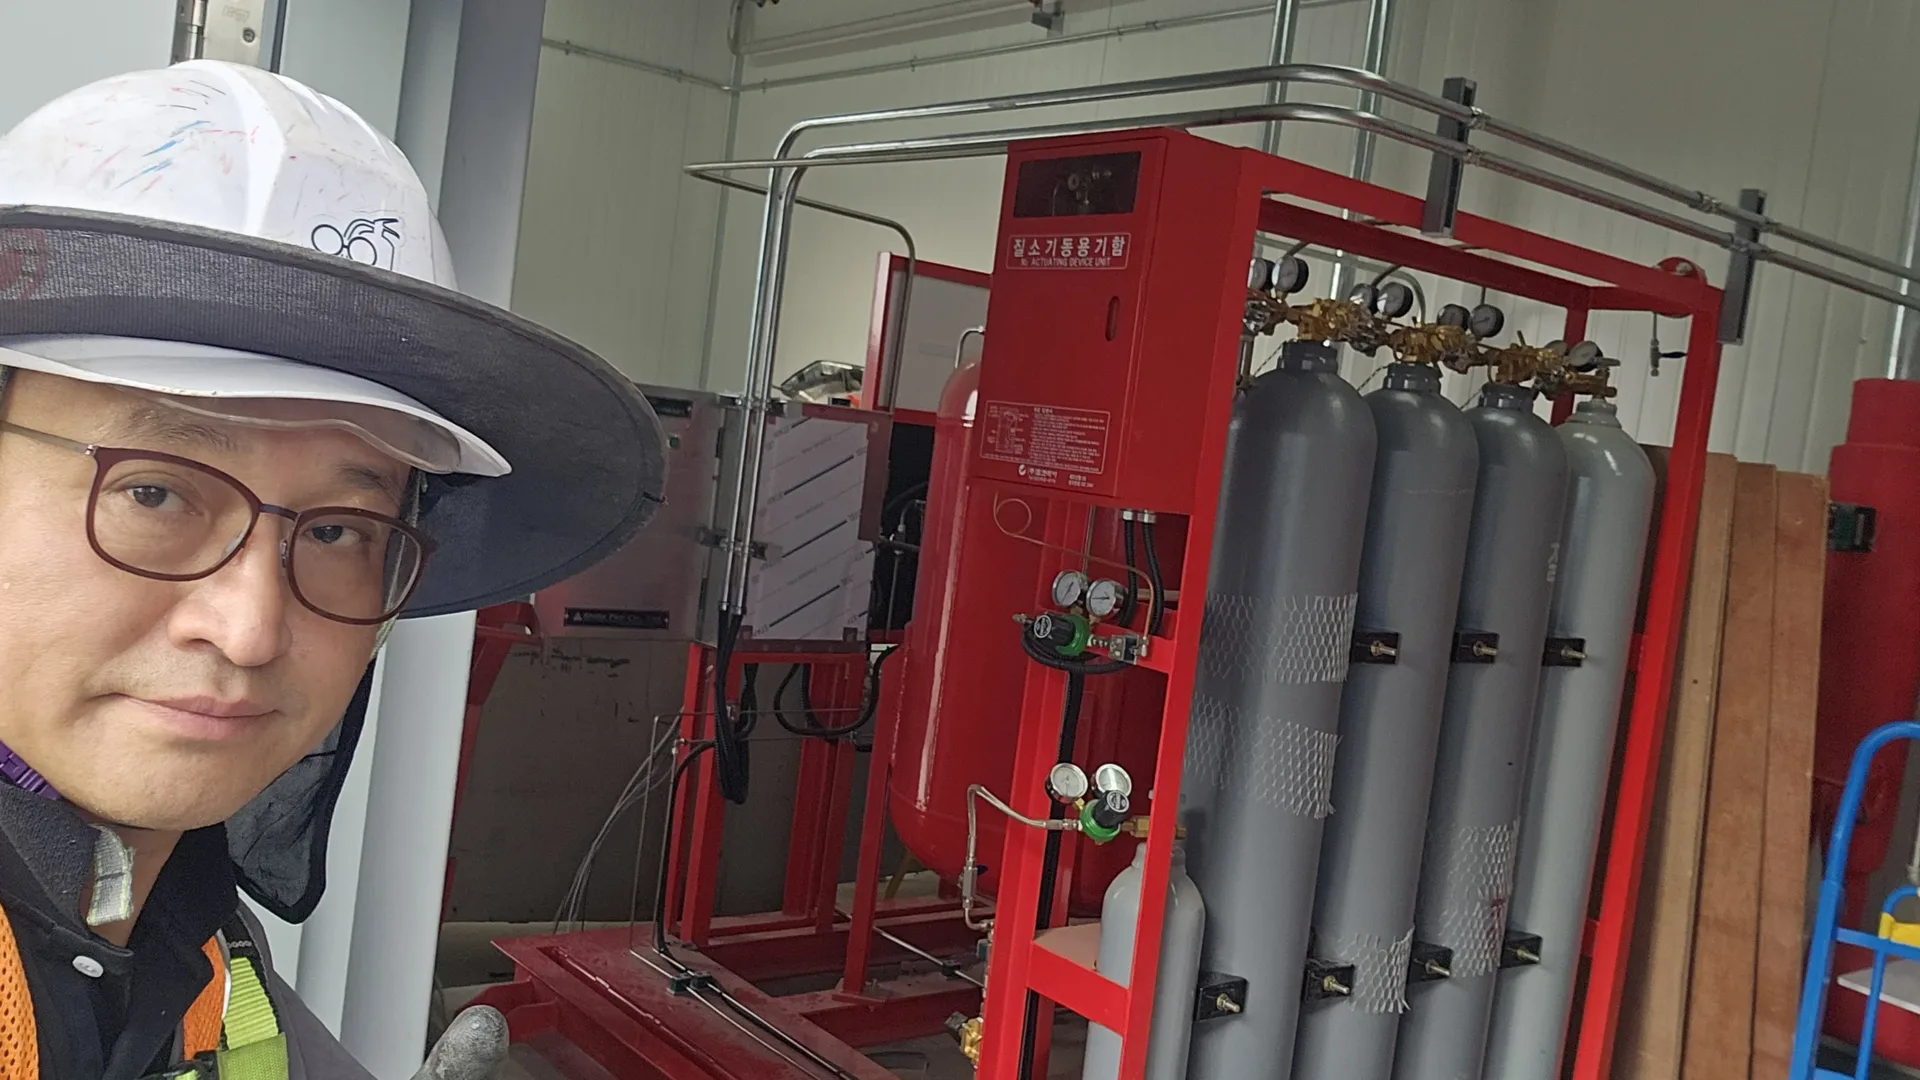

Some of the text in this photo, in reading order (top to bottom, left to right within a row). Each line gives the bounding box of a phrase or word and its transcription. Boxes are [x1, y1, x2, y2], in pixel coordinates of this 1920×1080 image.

[1030, 257, 1068, 267] ACTUATING
[1069, 257, 1094, 267] DEVICE
[1095, 257, 1111, 267] UNIT
